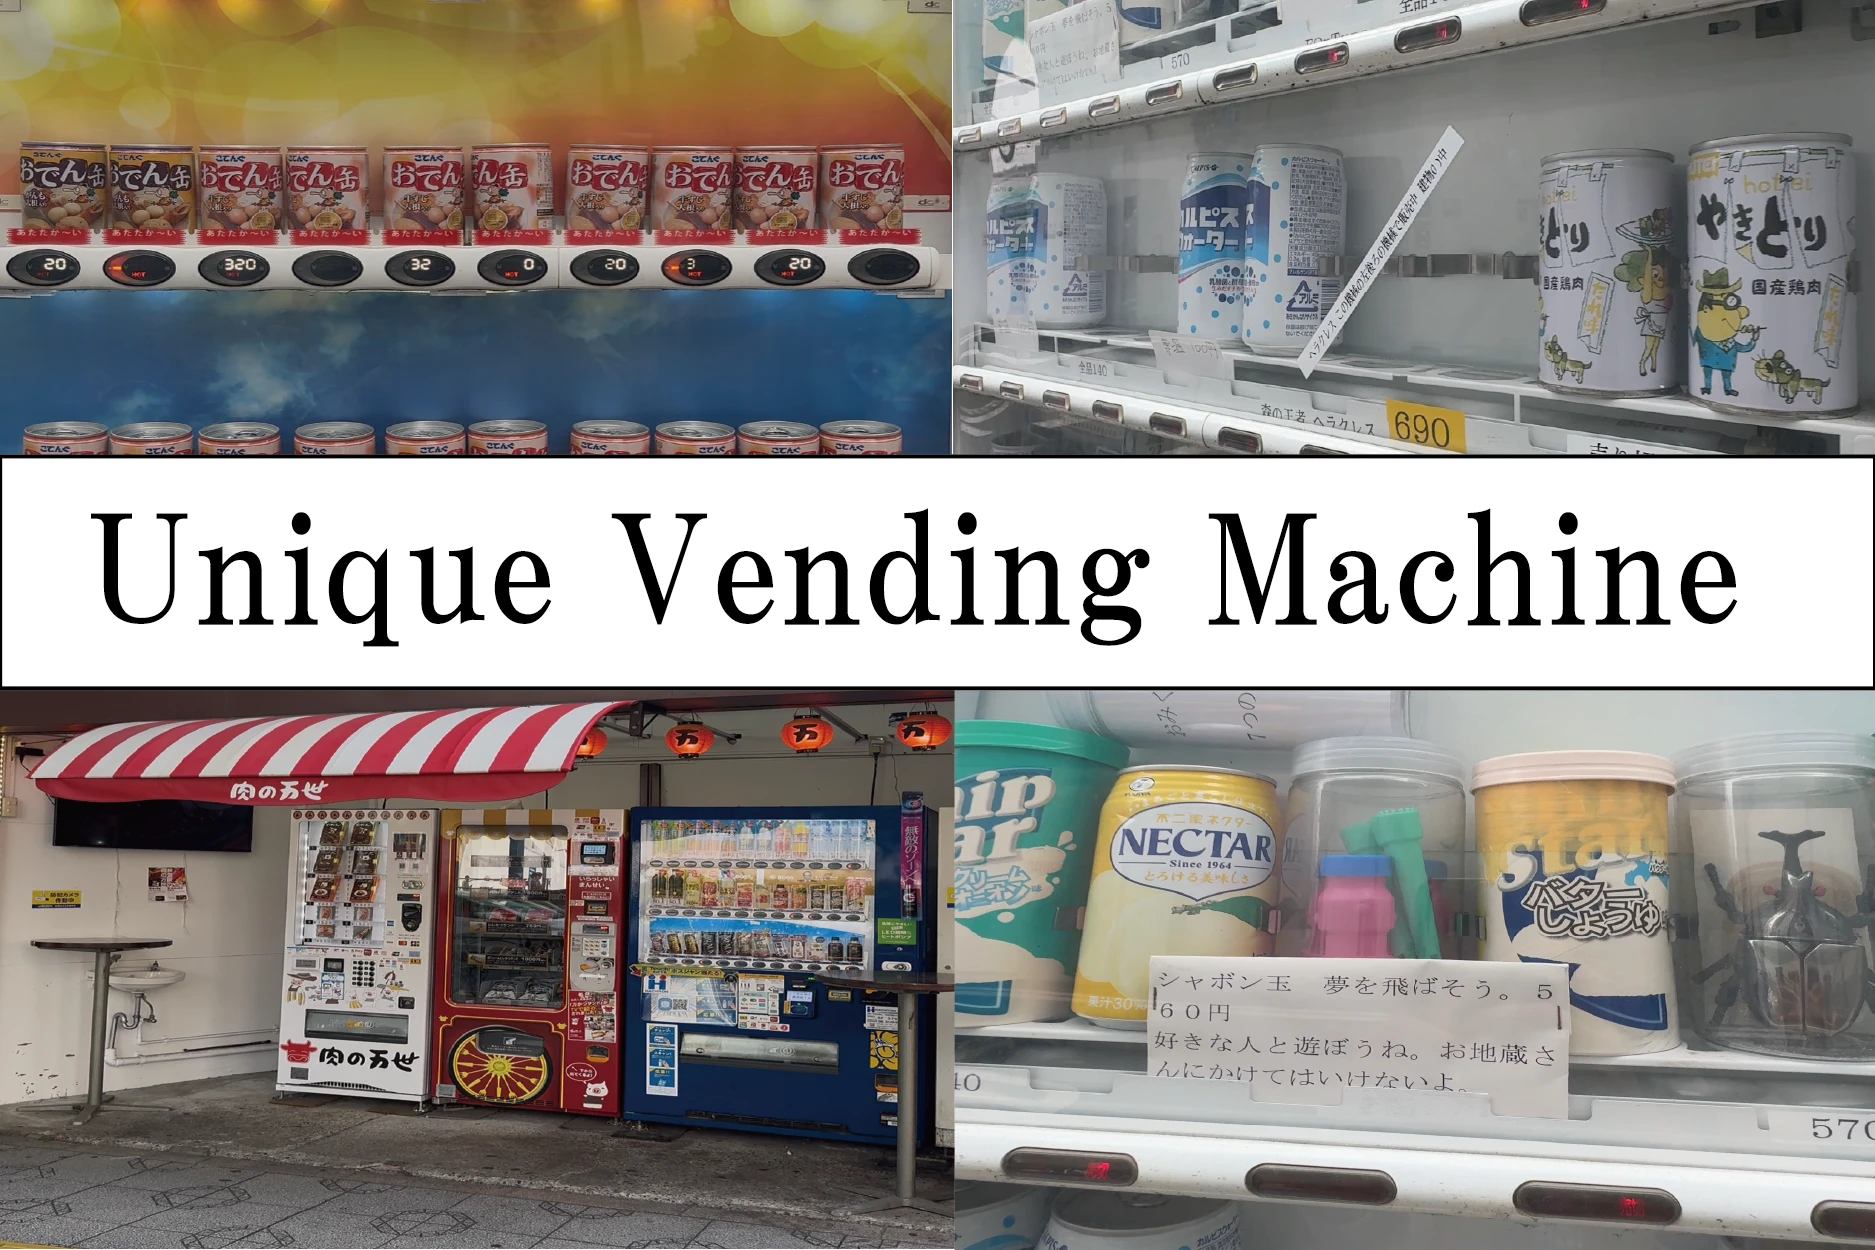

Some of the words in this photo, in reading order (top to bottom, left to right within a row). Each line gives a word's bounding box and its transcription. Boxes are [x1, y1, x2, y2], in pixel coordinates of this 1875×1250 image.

[1172, 53, 1190, 69] 570
[1744, 172, 1814, 194] hotei
[1697, 193, 1826, 258] やきとり
[44, 258, 66, 270] 20
[225, 258, 256, 270] 320
[411, 258, 431, 270] 32
[523, 258, 535, 270] 0
[605, 258, 626, 270] 20
[687, 258, 696, 270] 3
[789, 257, 811, 270] 20
[1544, 276, 1584, 291] 国産鶏肉
[1752, 279, 1821, 295] 国産鶏肉
[1299, 293, 1319, 304] アルミ
[1309, 320, 1338, 359] ヘラクレス
[1079, 361, 1107, 376] 全品140
[1261, 403, 1305, 423] 森の王者
[1313, 416, 1374, 435] ヘラクレス
[1395, 411, 1450, 448] 690
[230, 780, 329, 801] 肉の万世
[1156, 813, 1253, 828] 不二家ネクター
[905, 825, 919, 882] 無敵のゾーンへ
[1118, 828, 1271, 863] NECTAR
[1169, 860, 1203, 869] Since
[1207, 861, 1232, 870] 1964
[1144, 871, 1250, 885] とろける美味しさ
[1521, 877, 1645, 911] バター
[1535, 900, 1660, 939] しょうゆ
[1158, 971, 1292, 992] シャボン玉
[1323, 976, 1509, 1001] 夢を飛ばそう。
[1537, 984, 1553, 1000] 5
[1154, 1030, 1418, 1061] 好きな人と遊ぼうね。
[1440, 1042, 1555, 1067] お地蔵さ
[319, 1046, 420, 1072] 肉の万世
